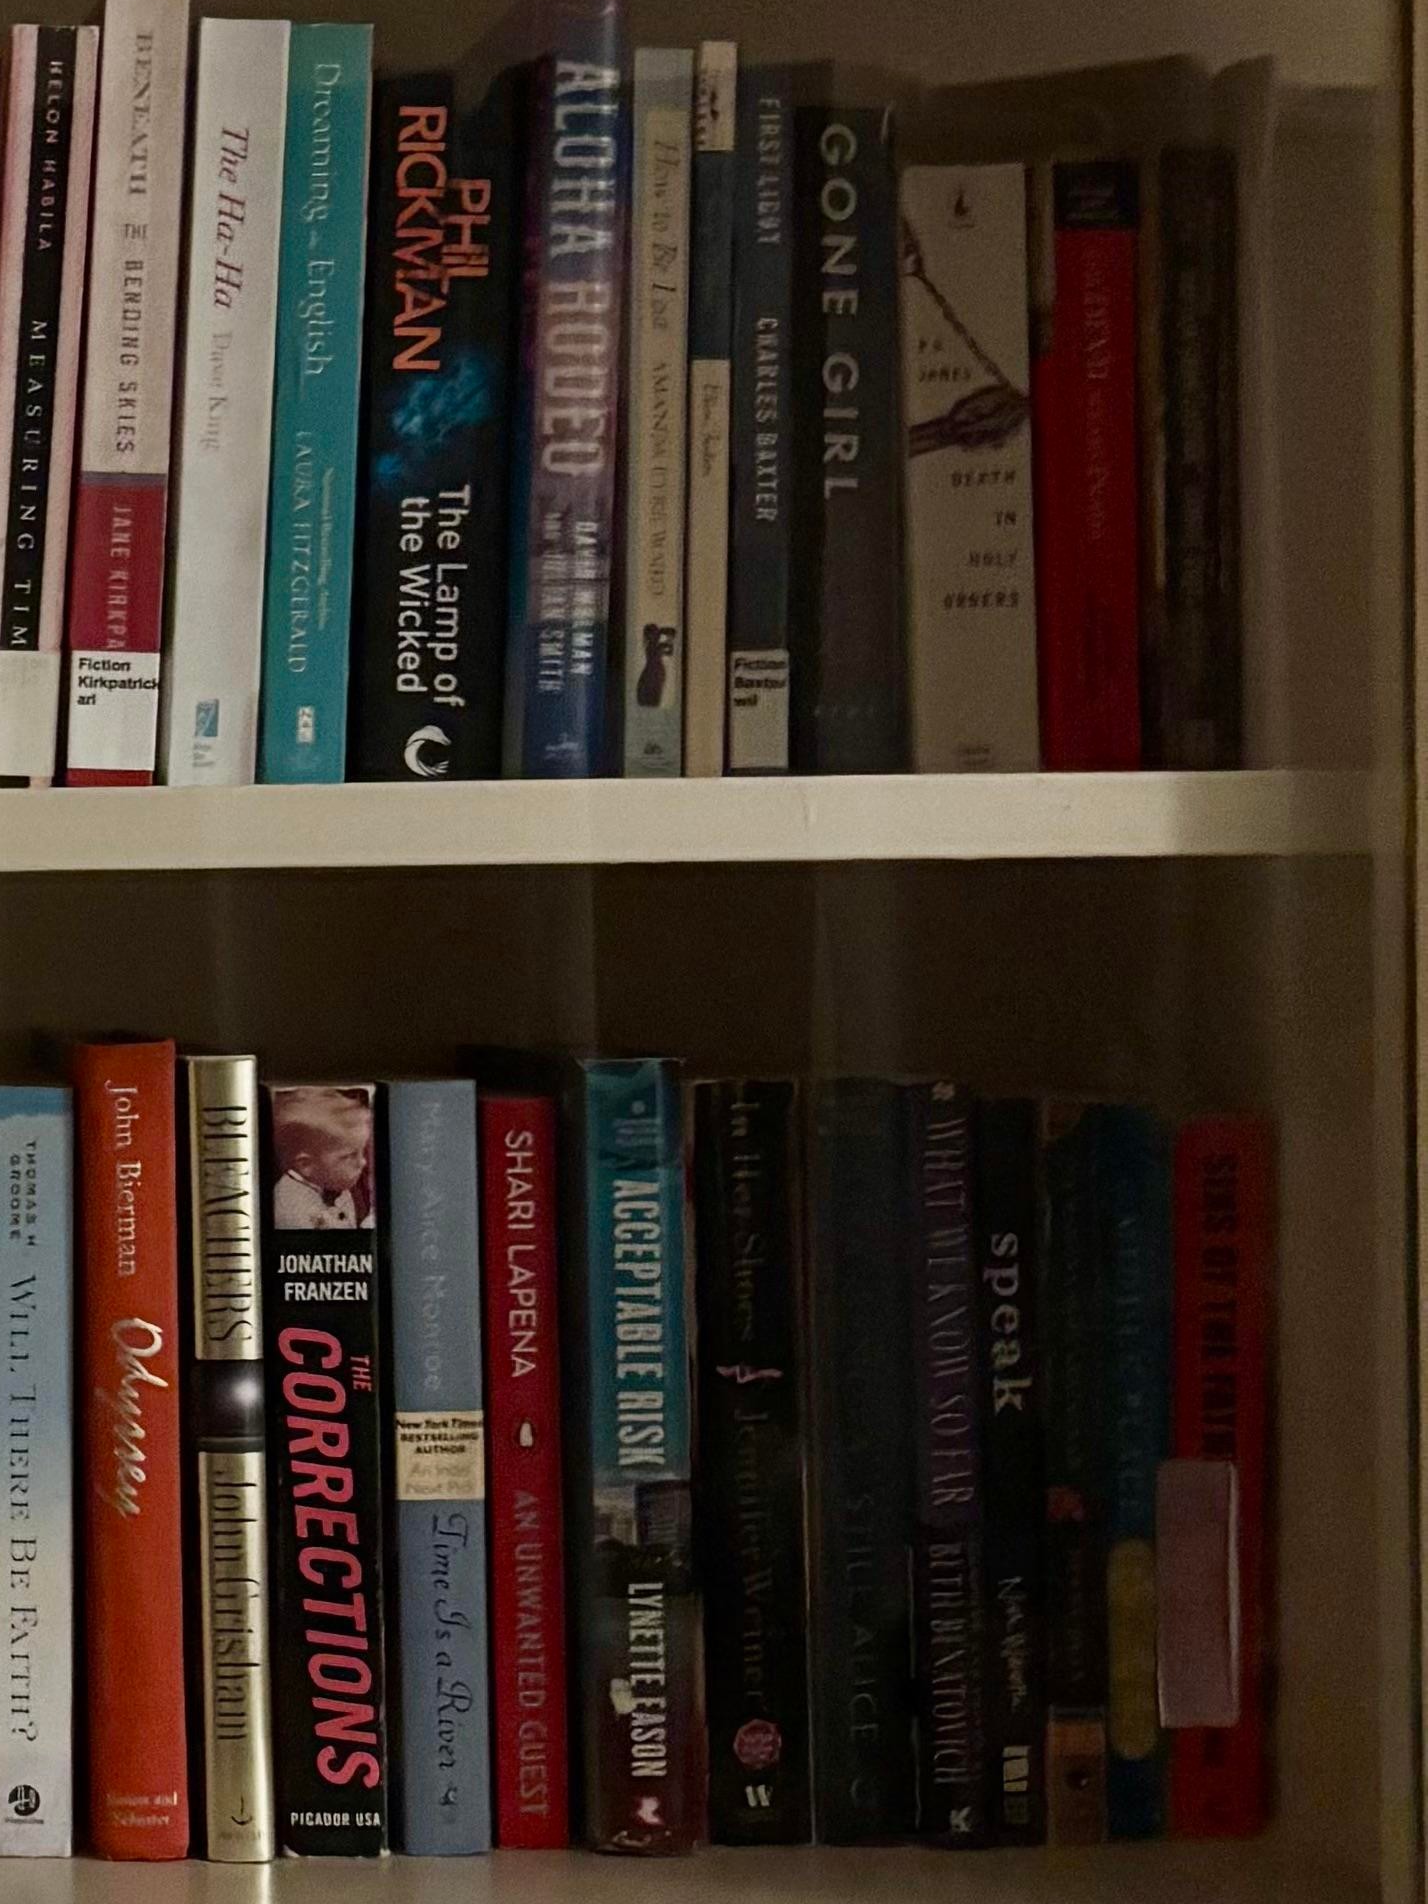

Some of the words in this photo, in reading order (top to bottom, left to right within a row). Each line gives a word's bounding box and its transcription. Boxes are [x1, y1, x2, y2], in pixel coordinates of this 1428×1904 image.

[389, 103, 450, 374] RICKMAN
[440, 176, 493, 293] PHIL
[818, 121, 860, 318] GONE
[821, 350, 863, 502] GIRL
[398, 495, 434, 553] the
[432, 484, 472, 549] The
[395, 561, 434, 696] Wicked
[426, 559, 470, 662] Lamp
[76, 674, 164, 693] Kirkpatrick
[78, 655, 134, 670] Fiction
[432, 670, 468, 709] of
[504, 1128, 538, 1232] SHARI
[274, 1252, 375, 1273] JONATHAN
[279, 1279, 370, 1301] FRANZEN
[506, 1242, 540, 1380] LAPENA
[612, 1178, 668, 1380] ACCEPTABLE
[348, 1352, 377, 1394] THE
[982, 1229, 1035, 1418] speak
[617, 1390, 666, 1467] RISK
[276, 1324, 384, 1790] CORRECTIONS
[625, 1581, 665, 1686] LYNETTE
[628, 1695, 667, 1778] EASON
[288, 1812, 350, 1828] PICADOR
[352, 1812, 382, 1828] USA
